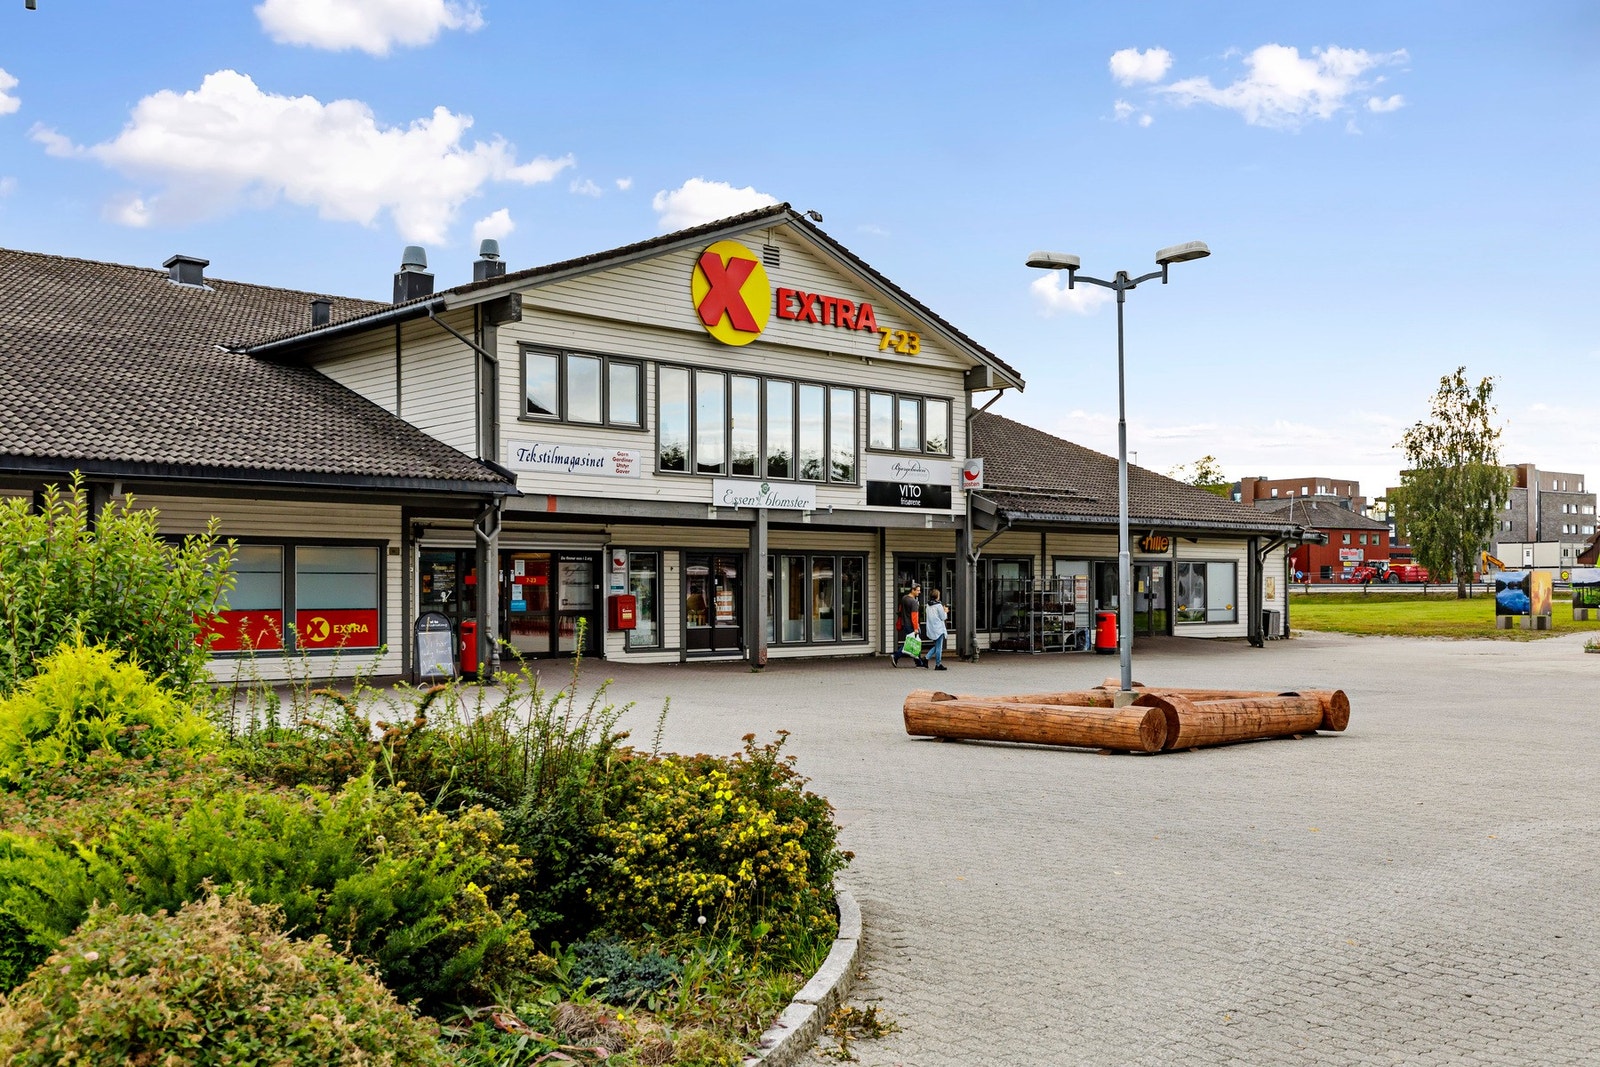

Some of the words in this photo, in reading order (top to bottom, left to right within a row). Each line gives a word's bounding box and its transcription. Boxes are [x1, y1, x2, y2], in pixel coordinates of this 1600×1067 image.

[698, 252, 761, 333] X
[776, 288, 878, 333] EXTRA
[877, 327, 921, 355] 7-23
[517, 444, 604, 472] Tekstilmagasinet
[765, 486, 809, 508] blomster
[899, 484, 922, 498] VITO
[1145, 536, 1169, 551] nille
